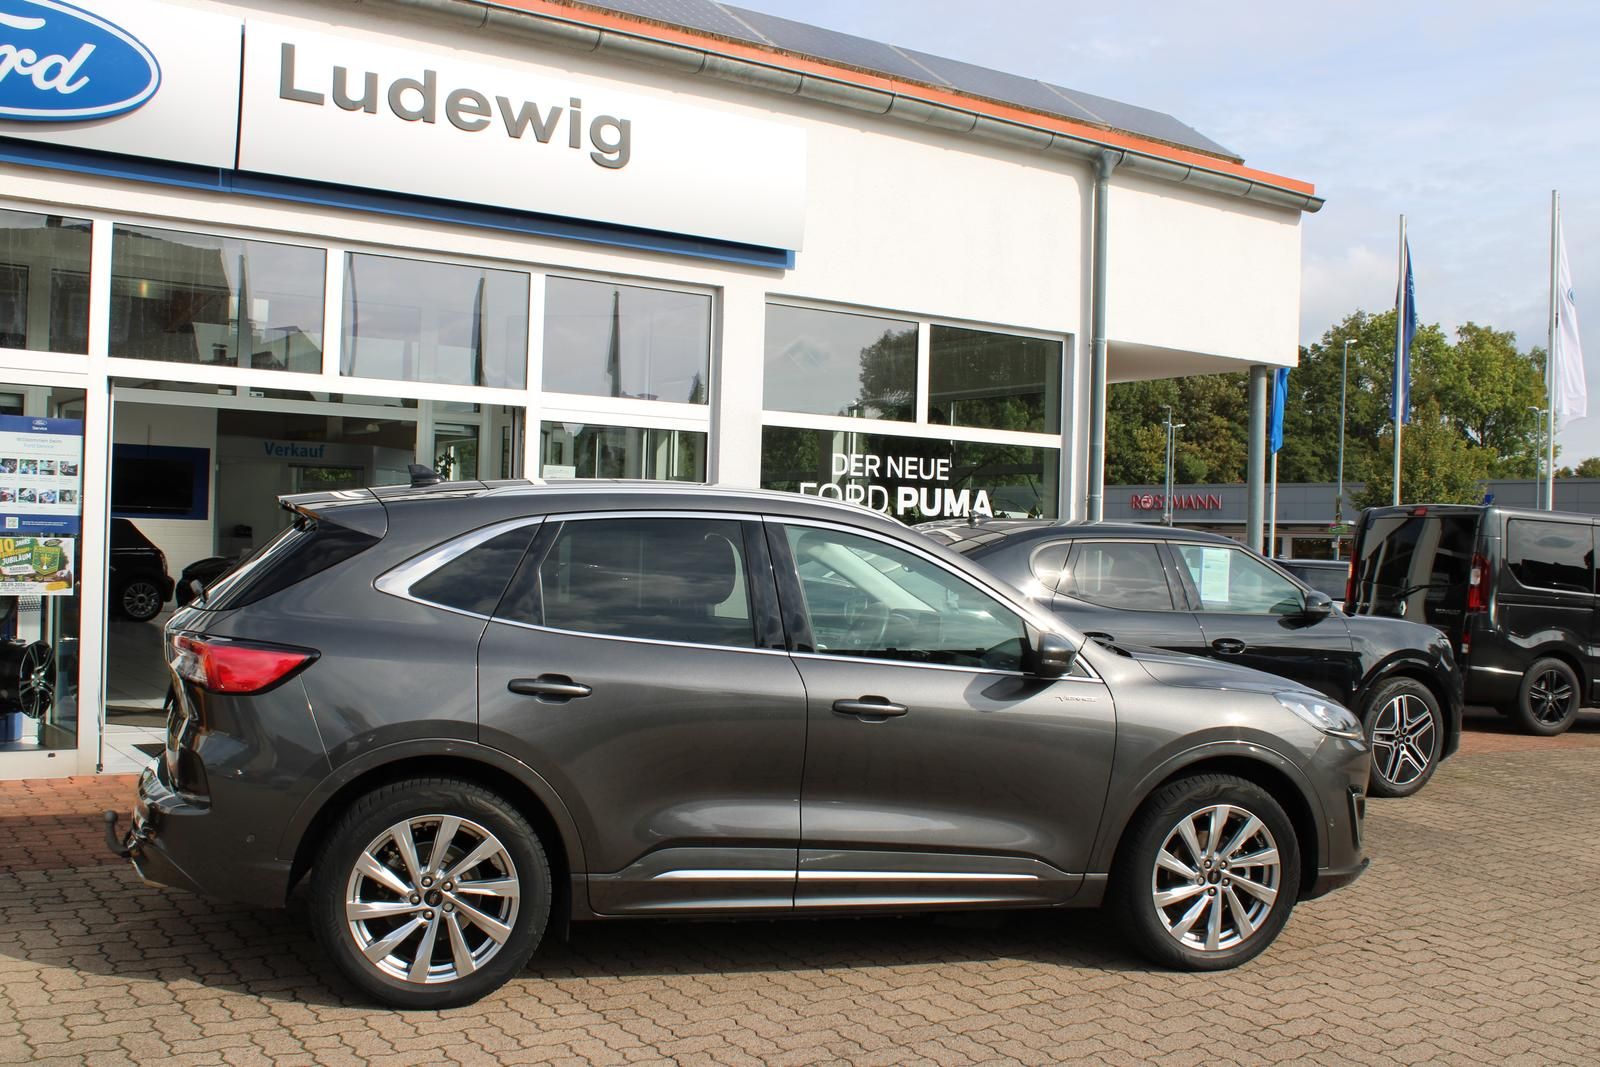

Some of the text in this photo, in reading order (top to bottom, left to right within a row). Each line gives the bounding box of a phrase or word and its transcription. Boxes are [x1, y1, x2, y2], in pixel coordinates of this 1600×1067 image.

[279, 42, 632, 170] Ludewig
[264, 441, 325, 458] Verkauf
[832, 453, 950, 481] DER NEUE
[896, 486, 993, 518] PUMA
